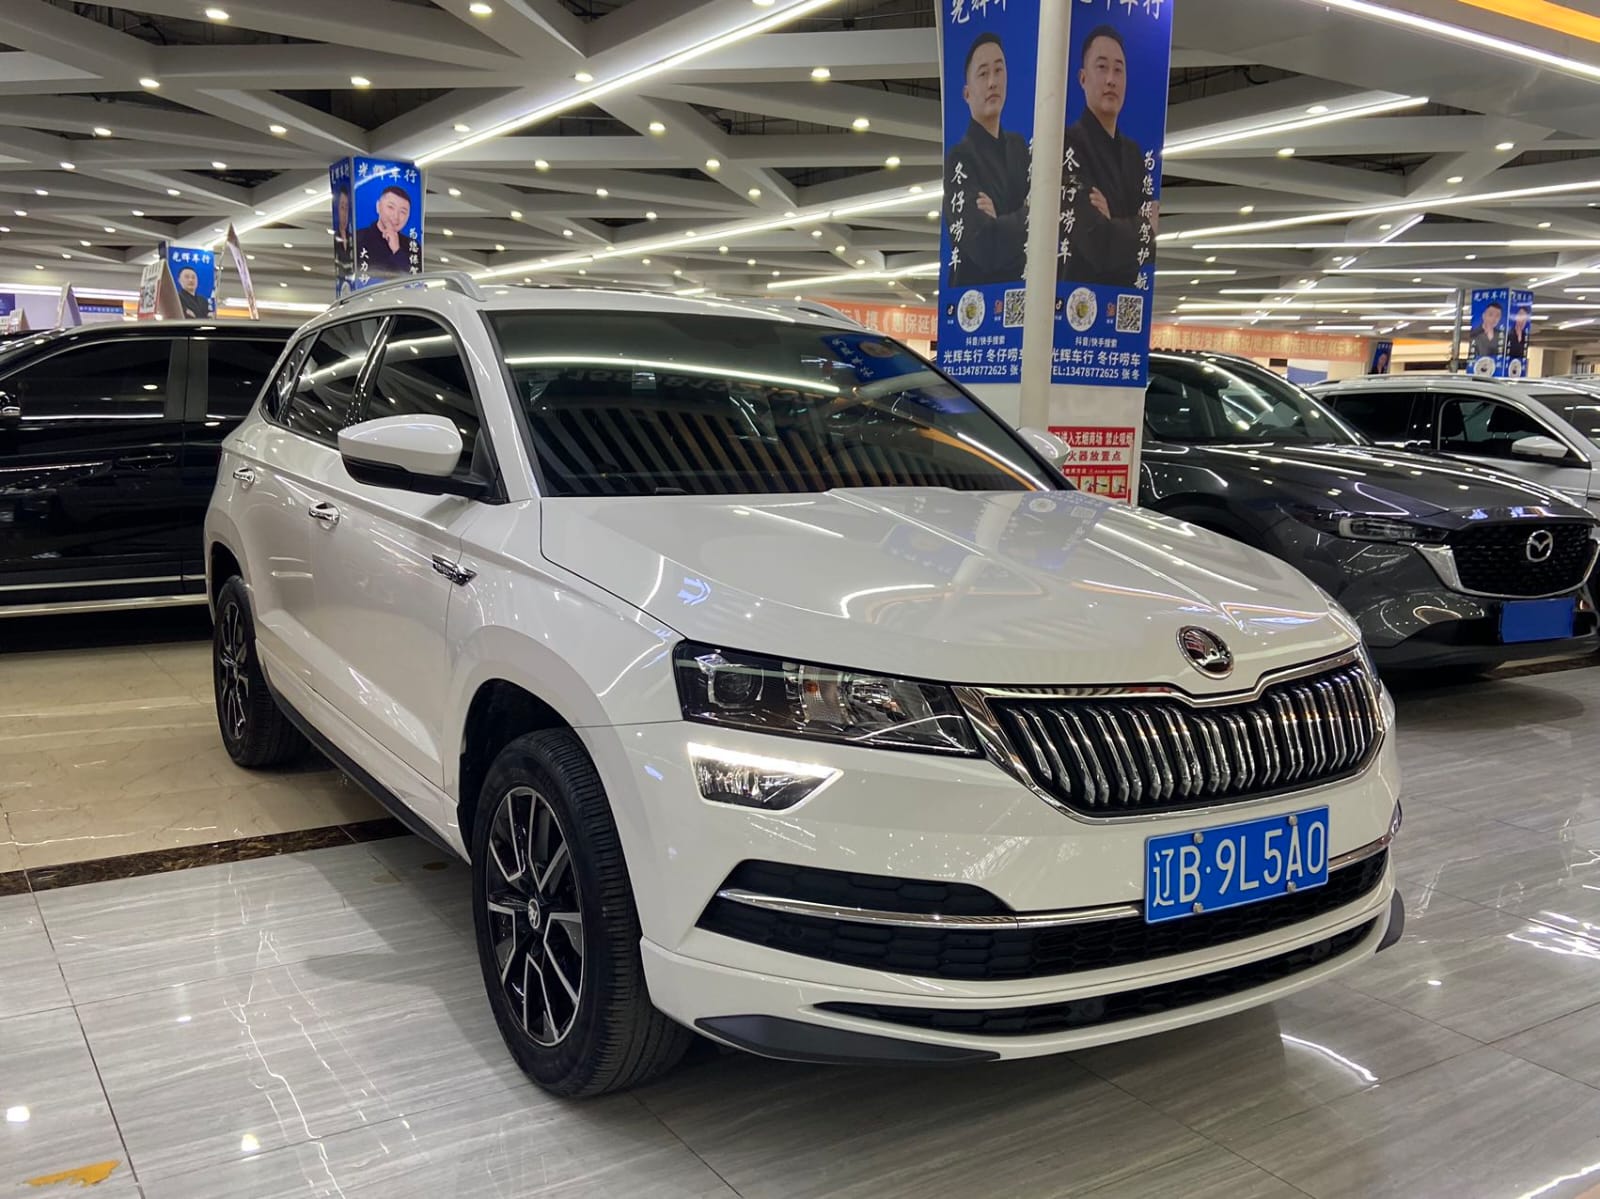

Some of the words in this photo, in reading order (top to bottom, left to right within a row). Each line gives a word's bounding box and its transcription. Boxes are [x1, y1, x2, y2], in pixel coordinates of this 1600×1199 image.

[358, 161, 418, 184] 光辉车行
[948, 161, 968, 272] 冬仔唠车
[1057, 147, 1081, 265] 冬仔唠车
[1134, 149, 1157, 291] 为您保驾护航
[943, 349, 983, 364] 光辉车行
[1097, 350, 1141, 367] 冬仔唠车
[1052, 366, 1119, 379] EL:13478772625
[1121, 369, 1140, 380] 张冬
[1105, 431, 1134, 446] 禁止吸烟
[1153, 821, 1326, 907] 辽B·9L5A0
